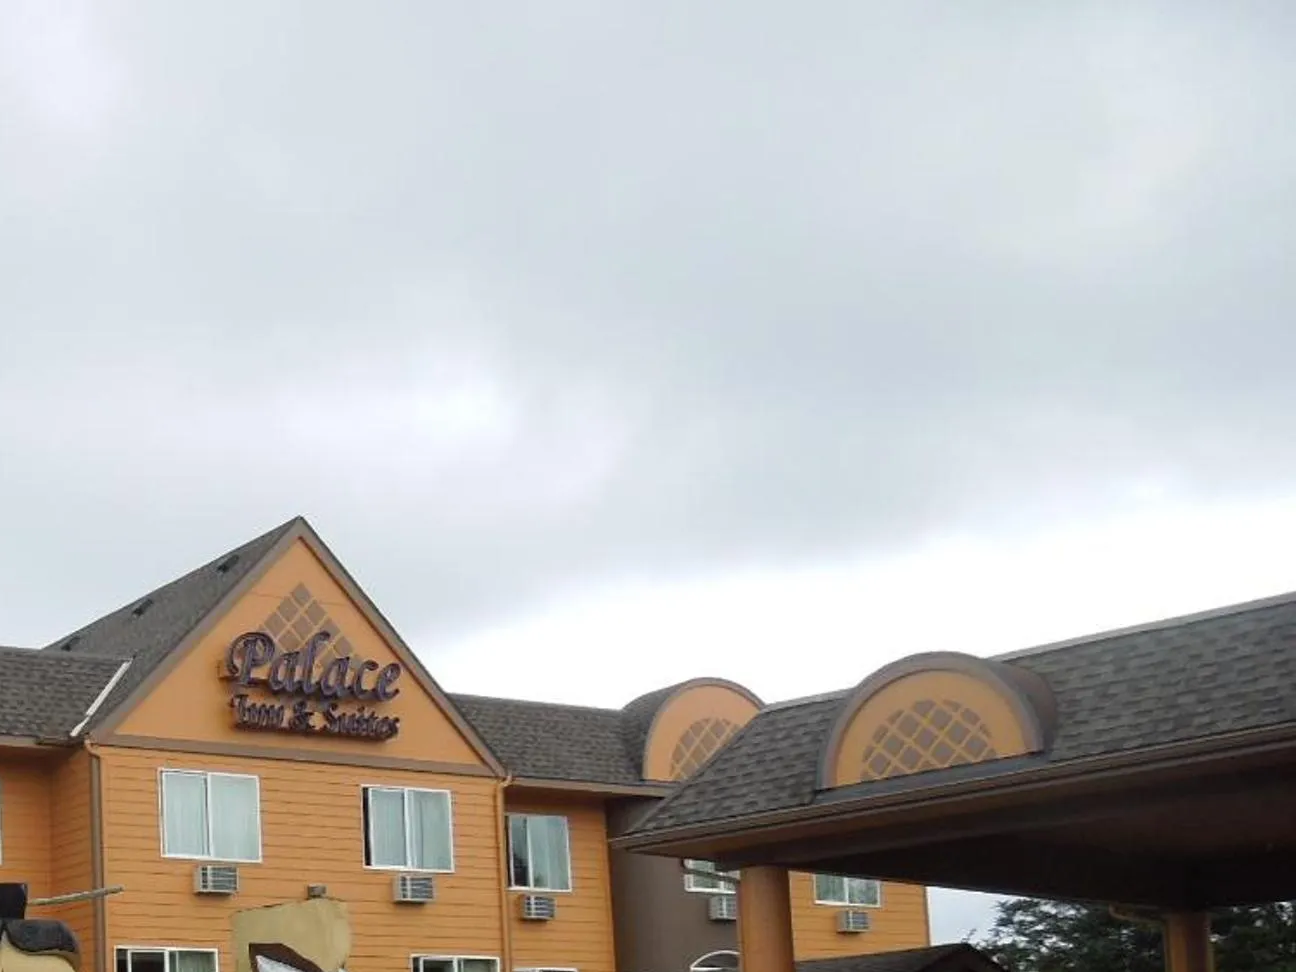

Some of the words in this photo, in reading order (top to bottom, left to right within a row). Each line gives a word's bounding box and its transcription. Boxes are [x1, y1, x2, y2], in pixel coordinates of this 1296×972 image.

[224, 630, 402, 701] Palace
[230, 694, 285, 729] Inn
[289, 701, 314, 732] &
[322, 703, 401, 740] Suites
